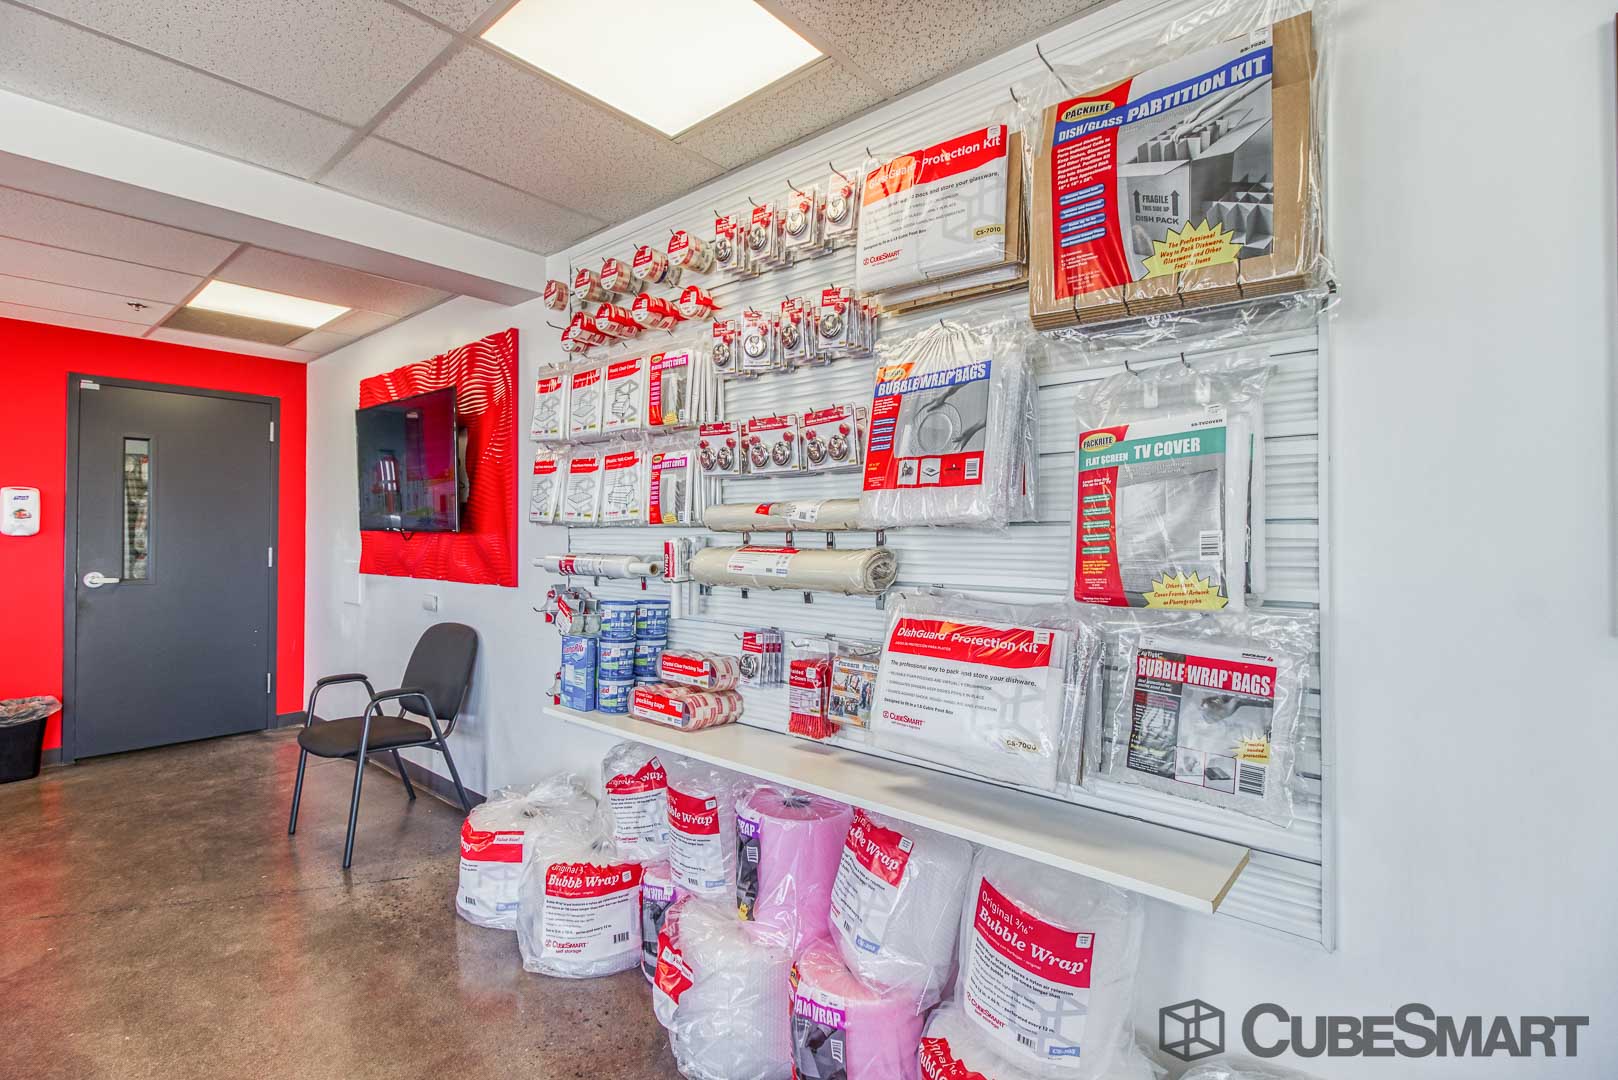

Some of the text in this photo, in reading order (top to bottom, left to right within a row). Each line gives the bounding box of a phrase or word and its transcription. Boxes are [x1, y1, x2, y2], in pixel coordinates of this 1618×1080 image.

[1059, 54, 1266, 142] DISH/GLASS PARTITION KIT
[1064, 102, 1112, 120] PACKRITE
[923, 143, 979, 167] Protection
[984, 136, 1000, 150] Kit
[941, 183, 954, 191] store
[1143, 195, 1168, 203] FRAGILE
[975, 226, 1001, 236] CS-7010
[1180, 232, 1215, 244] Professional
[1161, 250, 1174, 258] Way
[1181, 245, 1194, 253] Pack
[1205, 246, 1222, 254] Other
[673, 357, 686, 366] COVER
[878, 364, 986, 396] BUBBLE WRAP BAGS
[1083, 436, 1113, 449] PACKRITE
[1085, 437, 1201, 467] FLAT SCREEN TV COVER
[897, 627, 946, 641] DishGuard
[951, 633, 1016, 652] Protection
[1019, 641, 1039, 654] Kit
[899, 661, 927, 671] professional
[928, 665, 939, 673] way
[947, 668, 959, 676] pack
[973, 672, 988, 680] store
[990, 675, 1004, 683] your
[1005, 676, 1037, 687] dishware.
[1139, 657, 1271, 696] BUBBLE WRAP BAGS
[635, 697, 653, 707] packing
[682, 812, 713, 825] Wrap
[867, 841, 899, 870] Wrap
[585, 875, 619, 887] Wrap
[982, 890, 1013, 925] Original
[979, 906, 1085, 975] Bubble Wrap
